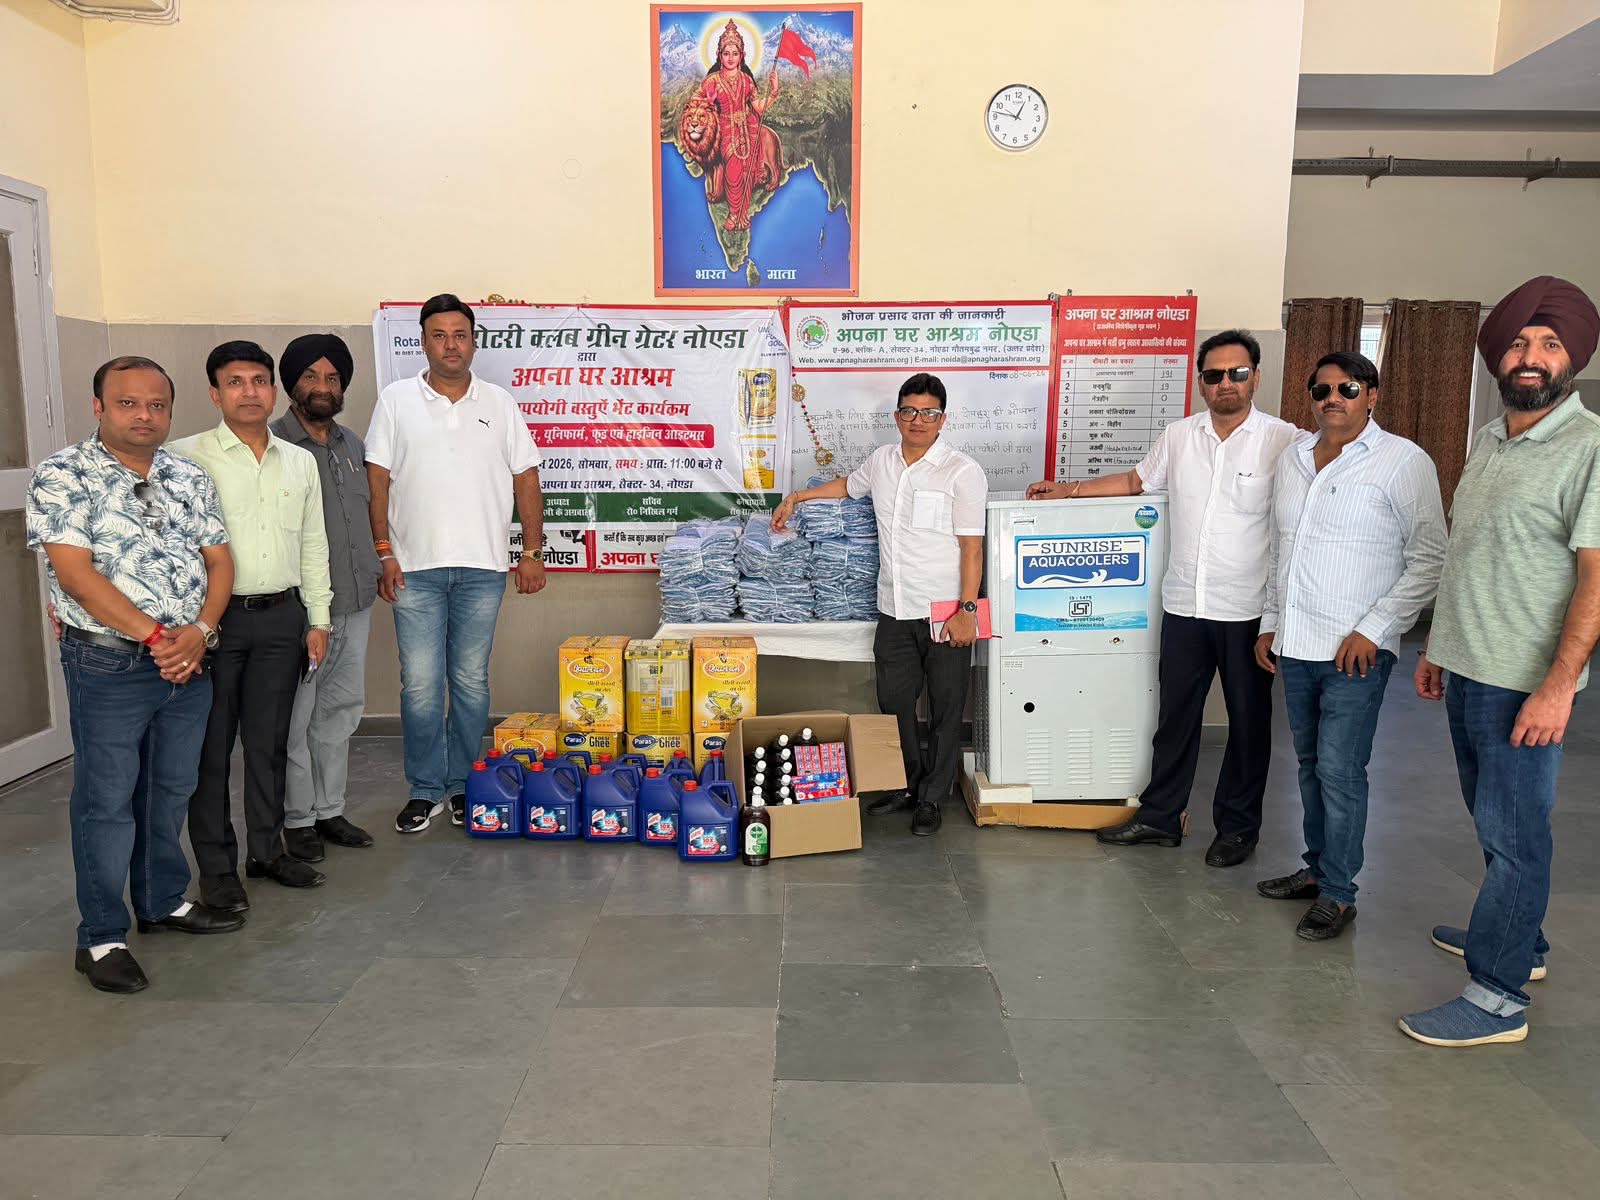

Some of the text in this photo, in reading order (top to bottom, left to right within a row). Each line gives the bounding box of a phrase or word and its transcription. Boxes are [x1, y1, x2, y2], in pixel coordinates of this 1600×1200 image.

[695, 269, 797, 280] भारत माता
[841, 307, 1006, 321] भोजन प्रसाद दाता की जानकारी
[1064, 304, 1191, 321] अपना घर आश्रम नोएडा
[530, 327, 582, 349] क्लब
[586, 323, 631, 349] ग्रीन
[634, 324, 679, 349] ग्रेटर
[682, 324, 749, 349] नोएडा
[836, 327, 888, 342] अपना
[893, 327, 920, 342] घर
[926, 327, 982, 342] आश्रम
[988, 321, 1042, 342] नोएडा
[394, 336, 420, 347] Rota
[511, 367, 676, 387] अपना घर आश्रम
[1065, 370, 1070, 379] 1
[1065, 383, 1070, 391] 2
[1064, 395, 1069, 404] 3
[518, 399, 567, 415] पयोगी
[637, 400, 692, 416] कार्यक्रम
[1063, 408, 1068, 416] 4
[1062, 420, 1068, 428] 5
[1061, 432, 1067, 440] 6
[1061, 444, 1066, 452] 7
[548, 458, 574, 471] 2026,
[670, 458, 696, 469] 11:00
[1060, 456, 1066, 464] 8
[540, 480, 569, 489] अपना
[570, 480, 582, 489] घर
[666, 478, 695, 489] नोएडा
[1041, 540, 1122, 554] SUNRISE
[600, 552, 646, 566] अपना
[1029, 554, 1129, 568] AQUACOOLERS
[589, 736, 610, 748] Ghee
[659, 736, 681, 748] Ghee
